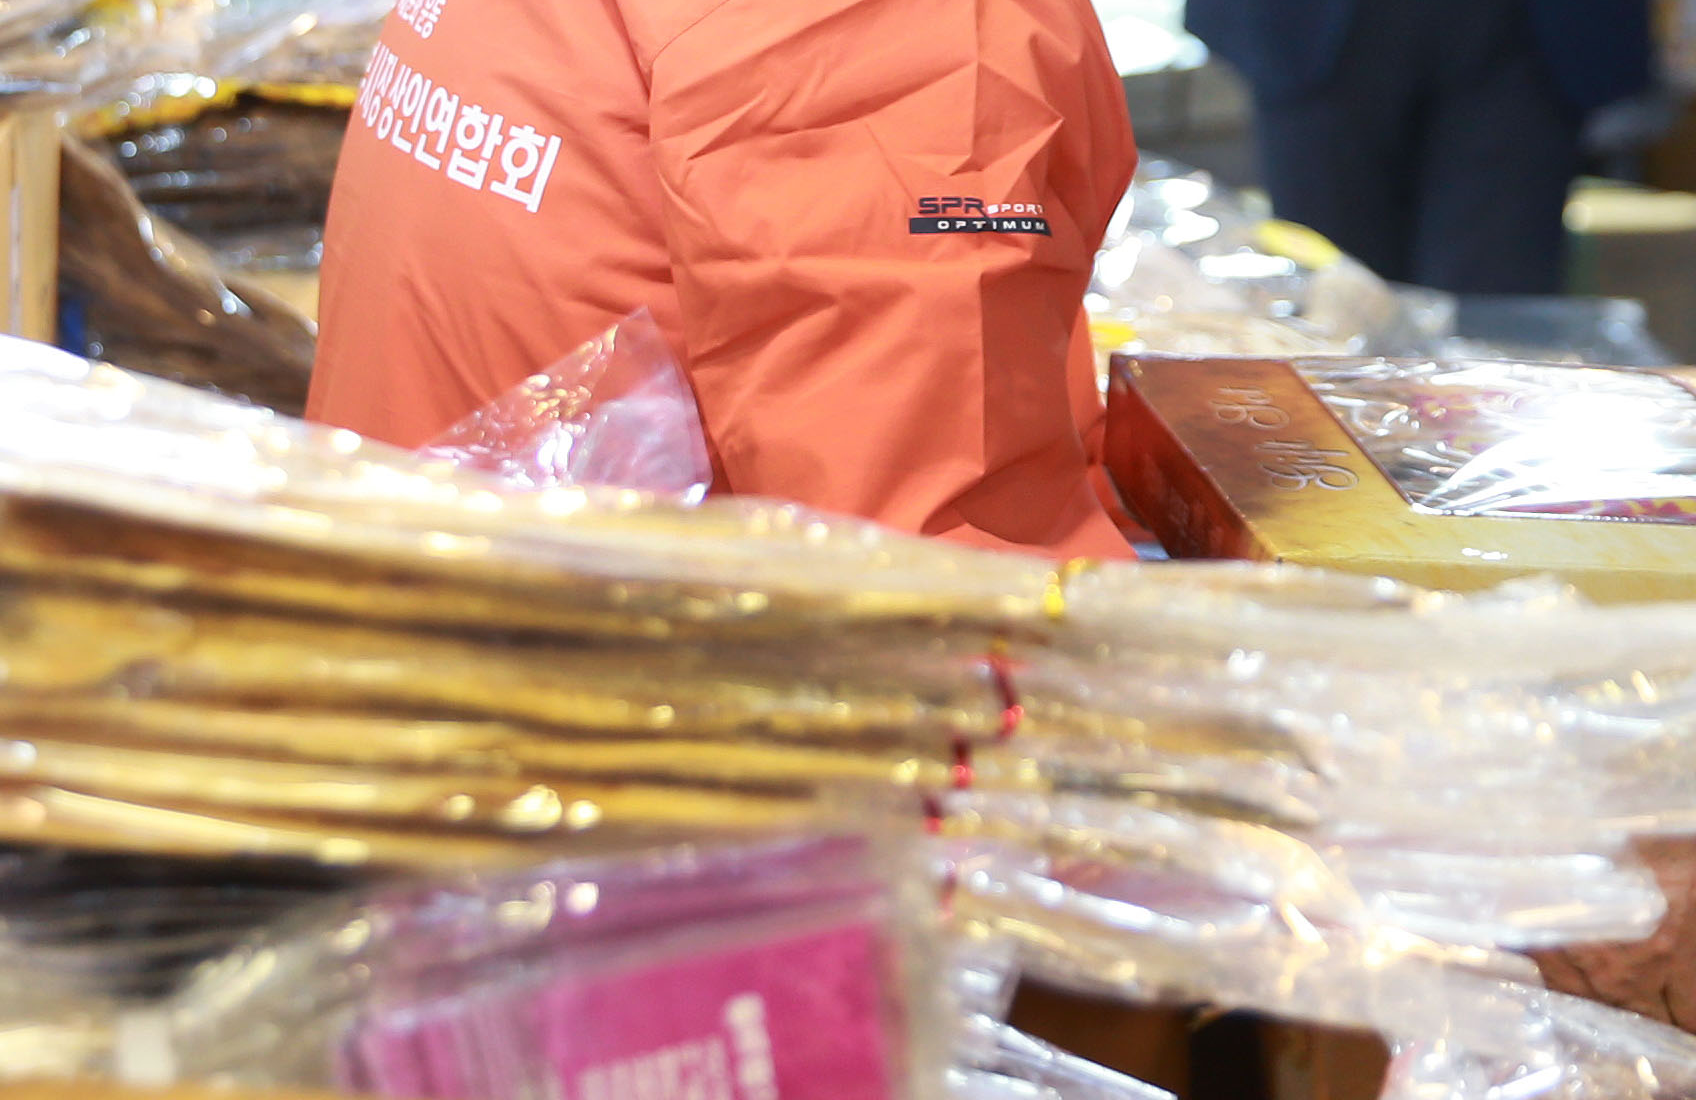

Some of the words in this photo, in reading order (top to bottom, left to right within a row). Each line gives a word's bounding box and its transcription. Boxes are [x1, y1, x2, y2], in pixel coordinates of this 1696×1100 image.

[359, 41, 562, 213] 시장상인연합회
[918, 197, 987, 219] SPR
[937, 220, 1046, 231] OPTIMUM
